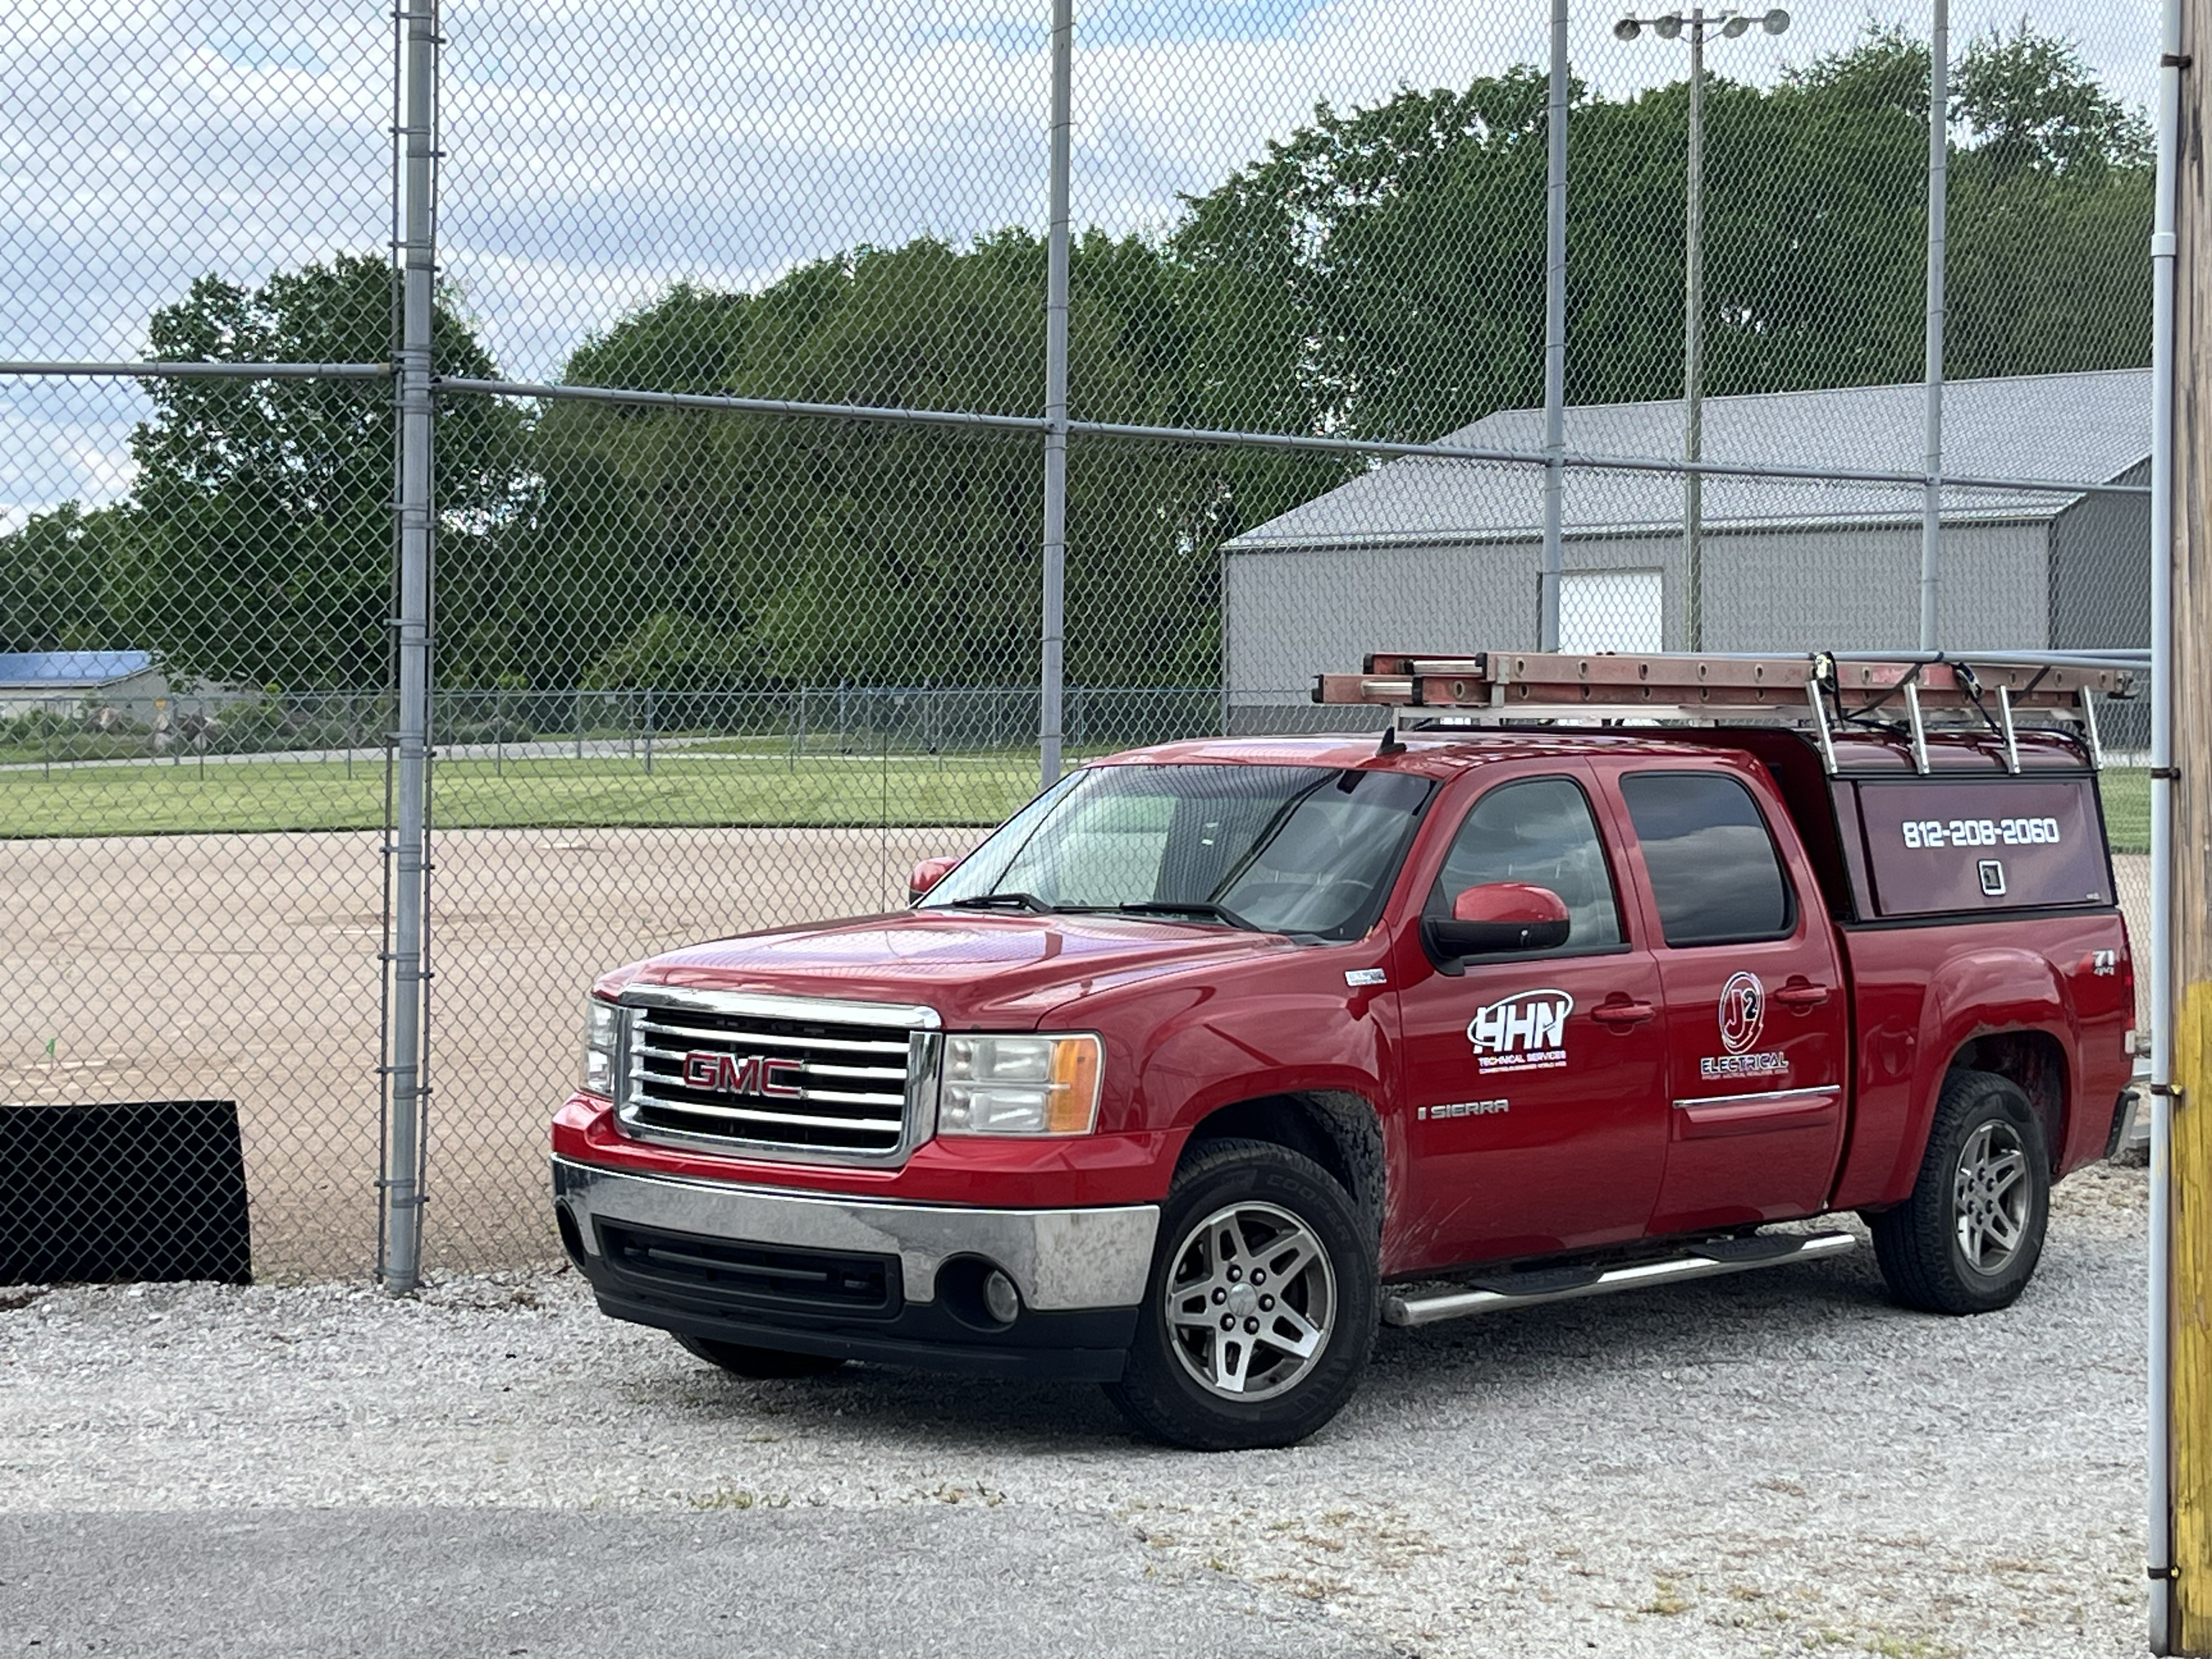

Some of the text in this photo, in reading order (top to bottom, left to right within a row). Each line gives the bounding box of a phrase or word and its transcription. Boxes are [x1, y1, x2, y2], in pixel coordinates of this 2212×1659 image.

[1903, 818, 2059, 848] 812-208-2060
[1473, 1001, 1565, 1054] HHN
[684, 1049, 804, 1100] GMC
[1701, 1052, 1789, 1074] ELECTRICAL
[1431, 1099, 1509, 1119] SIERRA
